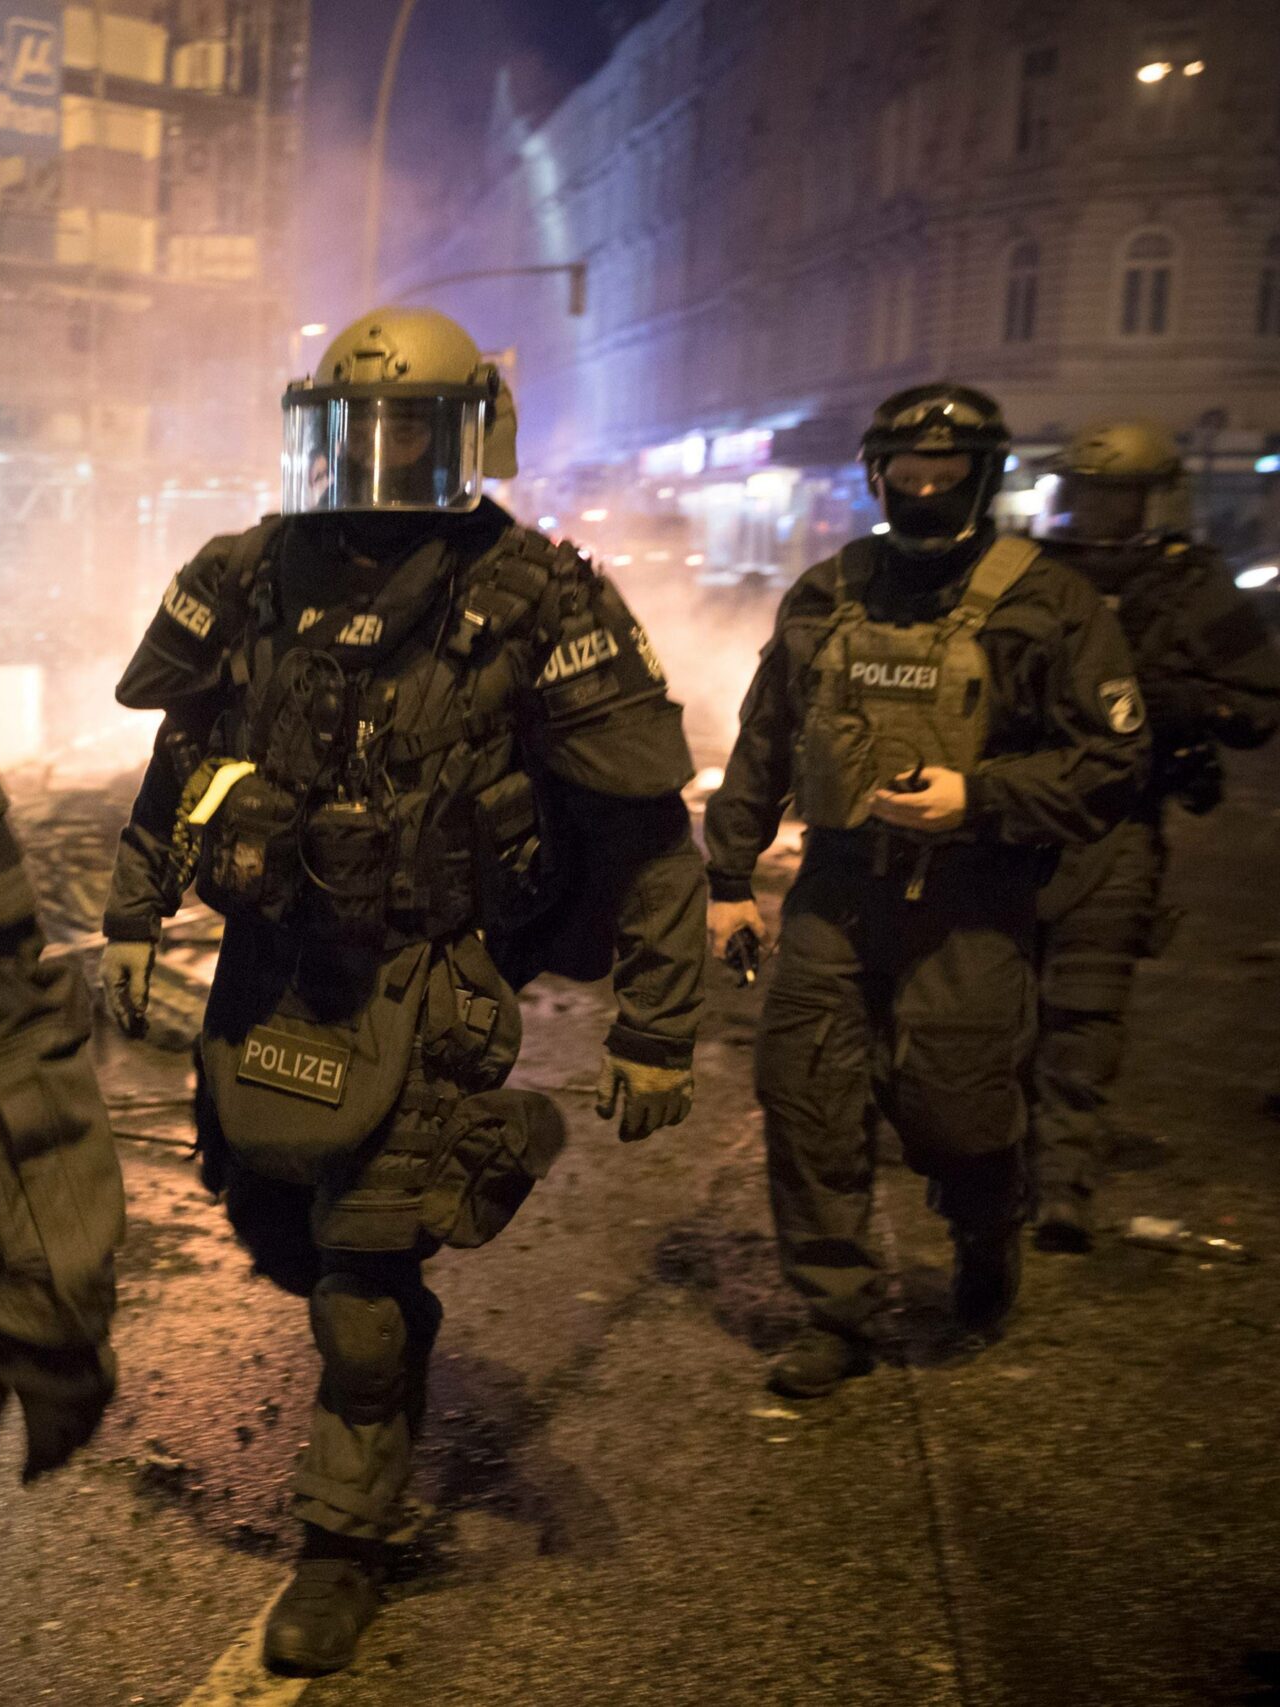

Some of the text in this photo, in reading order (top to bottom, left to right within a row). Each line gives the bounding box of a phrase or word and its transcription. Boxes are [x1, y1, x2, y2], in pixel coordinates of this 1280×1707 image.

[297, 606, 383, 646] PIZEI
[535, 628, 619, 688] OLIZEI
[850, 661, 938, 690] POLIZEI
[244, 1039, 343, 1089] POLIZEI
